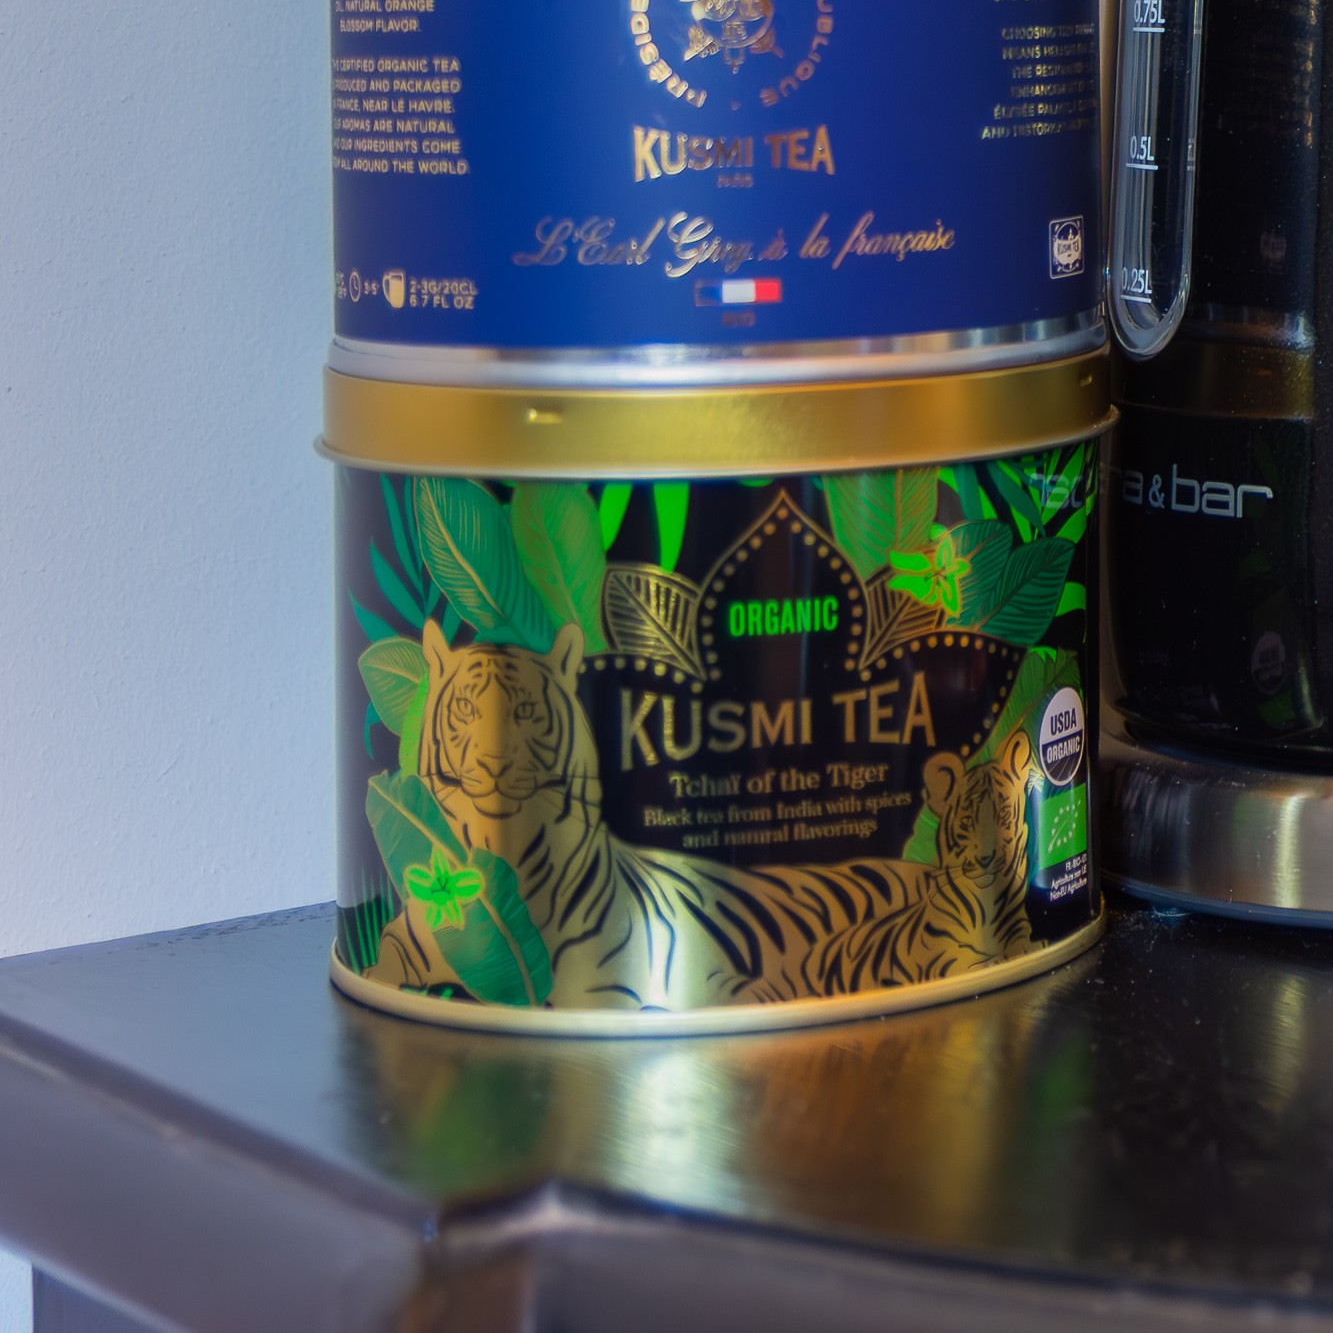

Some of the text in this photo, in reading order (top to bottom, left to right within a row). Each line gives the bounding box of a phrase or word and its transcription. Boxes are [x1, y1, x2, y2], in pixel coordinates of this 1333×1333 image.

[1133, 0, 1166, 24] 0.75L
[377, 58, 429, 73] ORGANIC
[433, 58, 461, 73] TEA
[369, 78, 390, 93] AND
[393, 78, 461, 94] PACKAGED
[363, 98, 388, 113] NEAR
[391, 98, 405, 113] LE
[373, 119, 393, 133] ARE
[396, 119, 455, 134] NATURAL
[354, 139, 418, 154] INGREDIENTS
[422, 139, 460, 154] COME
[633, 123, 836, 183] KUSMI TEA
[1130, 135, 1155, 161] 0.5L
[352, 158, 389, 173] AROUND
[392, 158, 414, 174] THE
[798, 212, 830, 260] la
[832, 209, 956, 271] française
[1121, 266, 1153, 295] 0.25L
[433, 295, 450, 309] FL
[453, 295, 474, 310] OZ
[1149, 473, 1165, 509] &
[1171, 463, 1274, 518] bar
[727, 594, 839, 638] ORGANIC
[620, 670, 937, 772] KUSMI TEA
[1050, 707, 1077, 736] USDA
[1047, 735, 1080, 764] ORGANIC
[746, 768, 776, 794] of
[781, 767, 821, 792] the
[826, 762, 889, 790] Tiger
[643, 790, 912, 827] Black tea from India with spices
[683, 816, 878, 849] and natural flavorings
